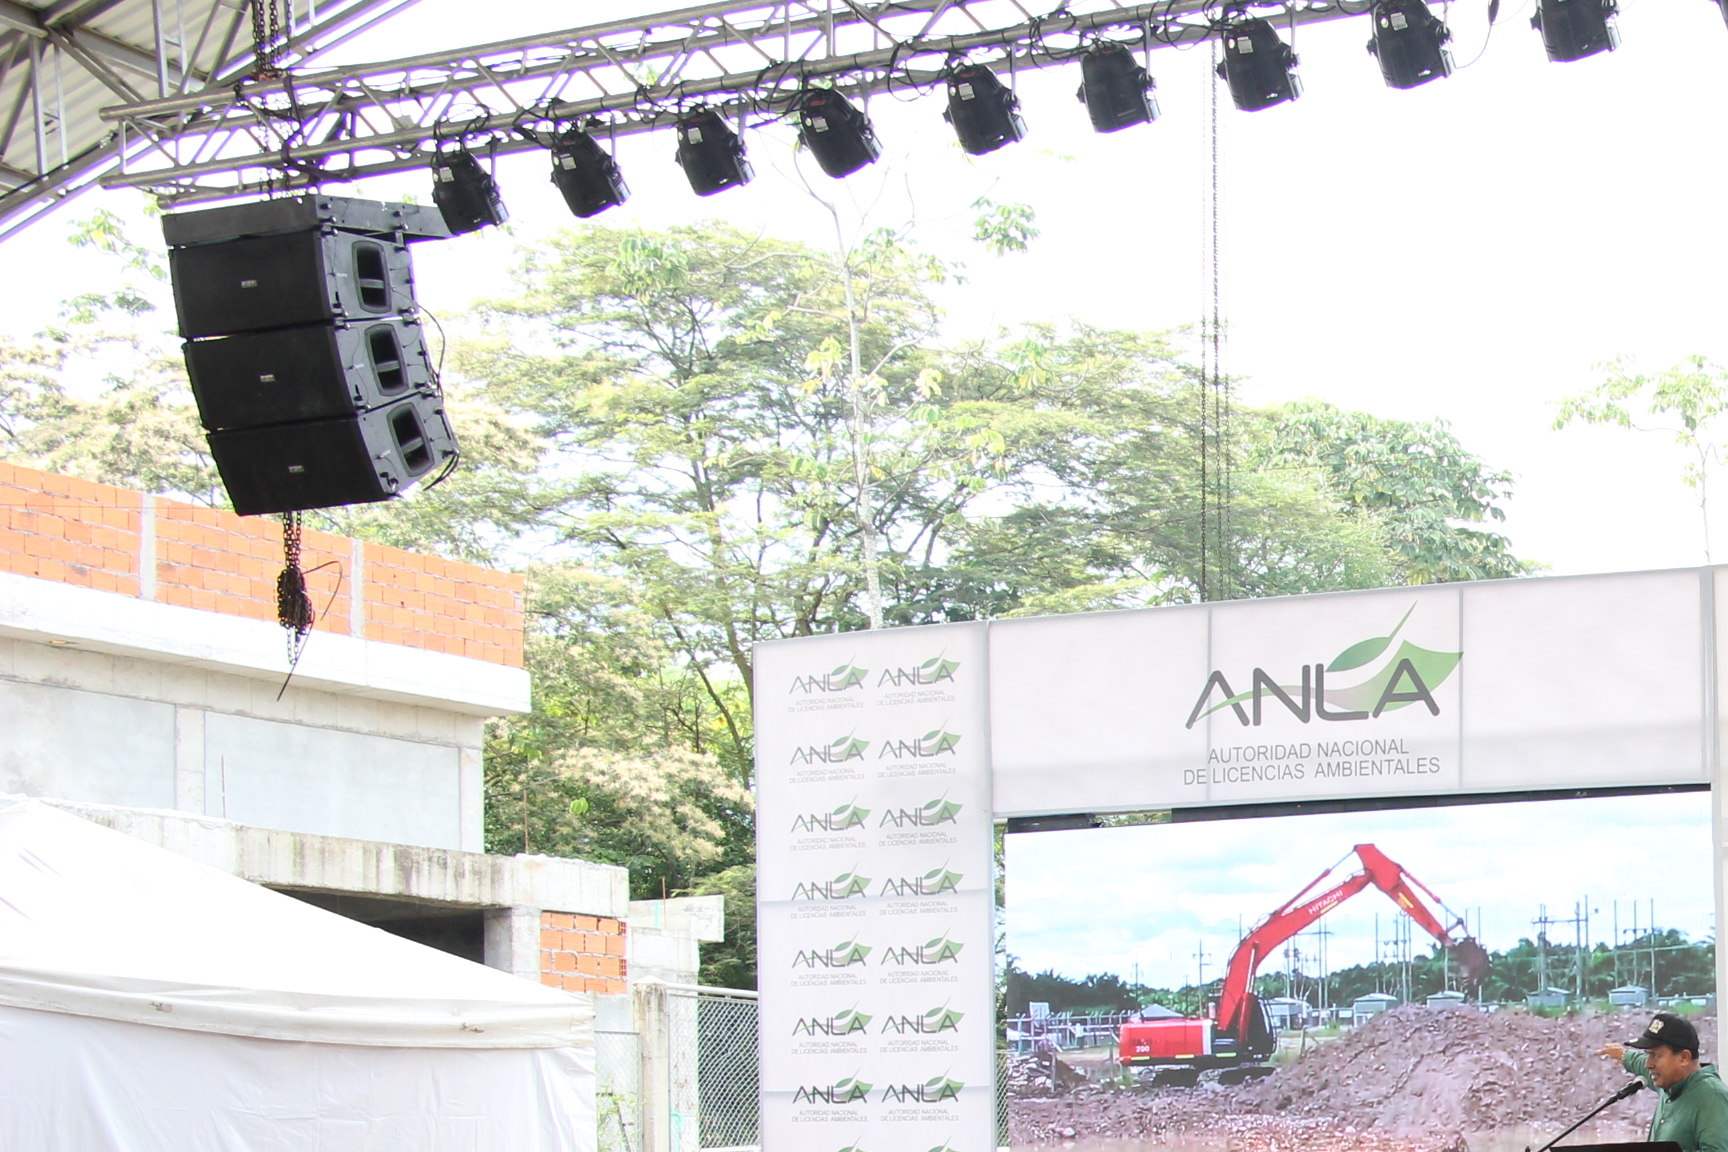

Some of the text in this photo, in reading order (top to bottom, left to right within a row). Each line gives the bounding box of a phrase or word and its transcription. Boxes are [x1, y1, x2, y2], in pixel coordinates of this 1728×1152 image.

[788, 670, 863, 695] ANLA
[877, 663, 954, 688] ANLA
[1185, 656, 1440, 729] ANLA
[789, 741, 864, 765] ANLA
[878, 735, 956, 759] ANLA
[1208, 738, 1409, 764] AUTORIDAD NACIONAL
[1184, 756, 1440, 785] DE LICENCIAS AMBIENTALES
[790, 810, 865, 833] ANLA
[879, 805, 957, 828] ANLA
[791, 879, 866, 901] ANLA
[879, 874, 957, 897] ANLA
[1308, 889, 1343, 915] HITACHI
[791, 947, 866, 968] ANLA
[880, 944, 958, 966] ANLA
[829, 978, 867, 986] AMBIENTALES
[888, 976, 917, 984] LICENCIAS
[919, 975, 958, 983] AMBIENTALES
[791, 1016, 867, 1036] ANLA
[880, 1013, 958, 1034] ANLA
[792, 1084, 867, 1104] ANLA
[881, 1083, 959, 1103] ANLA
